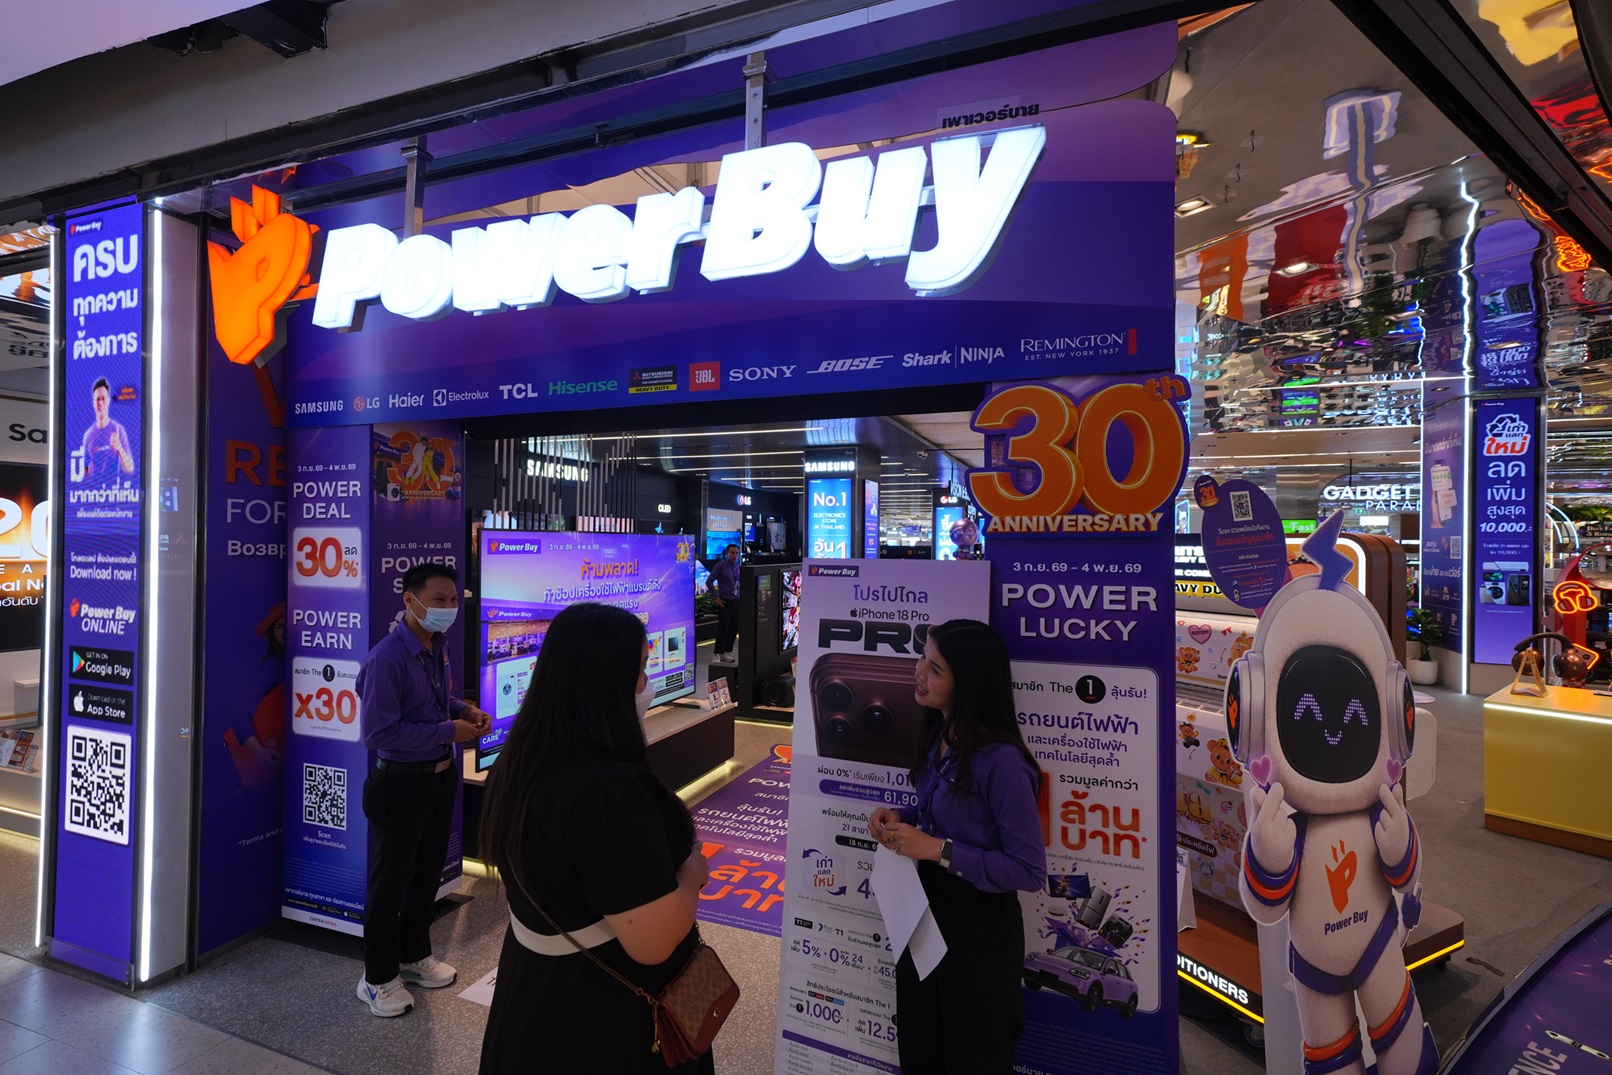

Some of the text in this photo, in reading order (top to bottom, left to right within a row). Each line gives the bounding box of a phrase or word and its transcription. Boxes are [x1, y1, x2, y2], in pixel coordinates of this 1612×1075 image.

[942, 103, 1040, 129] เพาเวอร์บาย
[311, 124, 1046, 331] Power Buy
[73, 234, 139, 282] ครบ
[73, 287, 138, 326] ทุกความ
[73, 329, 138, 360] ต้องการ
[1021, 332, 1126, 353] REMINGTON
[902, 347, 1005, 367] Shark NINJA
[1045, 352, 1065, 360] NEW
[1068, 350, 1094, 359] YORK
[1099, 348, 1119, 356] 1937
[812, 355, 890, 373] BOSE
[695, 370, 715, 384] JBL
[729, 365, 797, 382] SONY
[449, 390, 489, 402] Electrolux
[499, 383, 538, 400] TCL
[548, 380, 618, 396] Hisense
[294, 400, 343, 415] SAMSUNG
[367, 397, 380, 409] LG
[389, 392, 424, 409] Haier
[1486, 436, 1528, 455] ใหม่
[70, 446, 85, 483] มี
[315, 464, 324, 472] 69
[804, 461, 855, 473] SAMSUNG
[1487, 461, 1525, 478] ลด
[69, 478, 140, 503] มากกว่าที่เห็น
[293, 480, 361, 498] POWER
[1323, 485, 1414, 500] GADGET
[1487, 481, 1525, 501] เพิ่ม
[813, 491, 846, 507] No.1
[303, 502, 351, 519] DEAL
[1487, 504, 1525, 519] สูงสุด
[987, 513, 1164, 533] ANNIVERSARY
[344, 546, 357, 555] ลด
[499, 542, 538, 553] Power Buy
[296, 537, 343, 577] 30
[70, 566, 132, 580] Download now
[580, 557, 639, 579] ห้ามพลาด!
[818, 567, 856, 577] Power Buy
[1013, 563, 1142, 573] 3 ก.ย. 69 4 พ.ย. 69
[854, 585, 928, 604] โปรไปไกล
[1002, 583, 1158, 612] POWER
[80, 604, 136, 623] Power Buy
[293, 609, 361, 629] POWER
[858, 608, 930, 621] iPhone 18 Pro
[81, 618, 126, 635] ONLINE
[1020, 616, 1138, 641] LUCKY
[301, 631, 352, 650] EARN
[85, 661, 132, 679] Google Play
[1049, 681, 1074, 693] The
[1111, 685, 1147, 700] ลุ้นรับ!
[87, 704, 126, 718] App Store
[1017, 711, 1139, 736] รถยนต์ไฟฟ้า
[1028, 733, 1128, 753] และเครื่องใช้ไฟฟ้า
[1035, 750, 1120, 768] เทคโนโลยีสุดล้ำ
[818, 765, 834, 776] ผ่อน
[853, 769, 884, 783] เริ่มเพียง
[1059, 774, 1139, 791] รวมมูลค่ากว่า
[1060, 790, 1140, 832] ล้าน
[317, 830, 332, 839] Scan
[842, 823, 850, 831] 21
[816, 856, 833, 868] เก่า
[709, 859, 785, 893] ล้า
[813, 874, 835, 887] ใหม่
[1324, 910, 1368, 935] Power Buy
